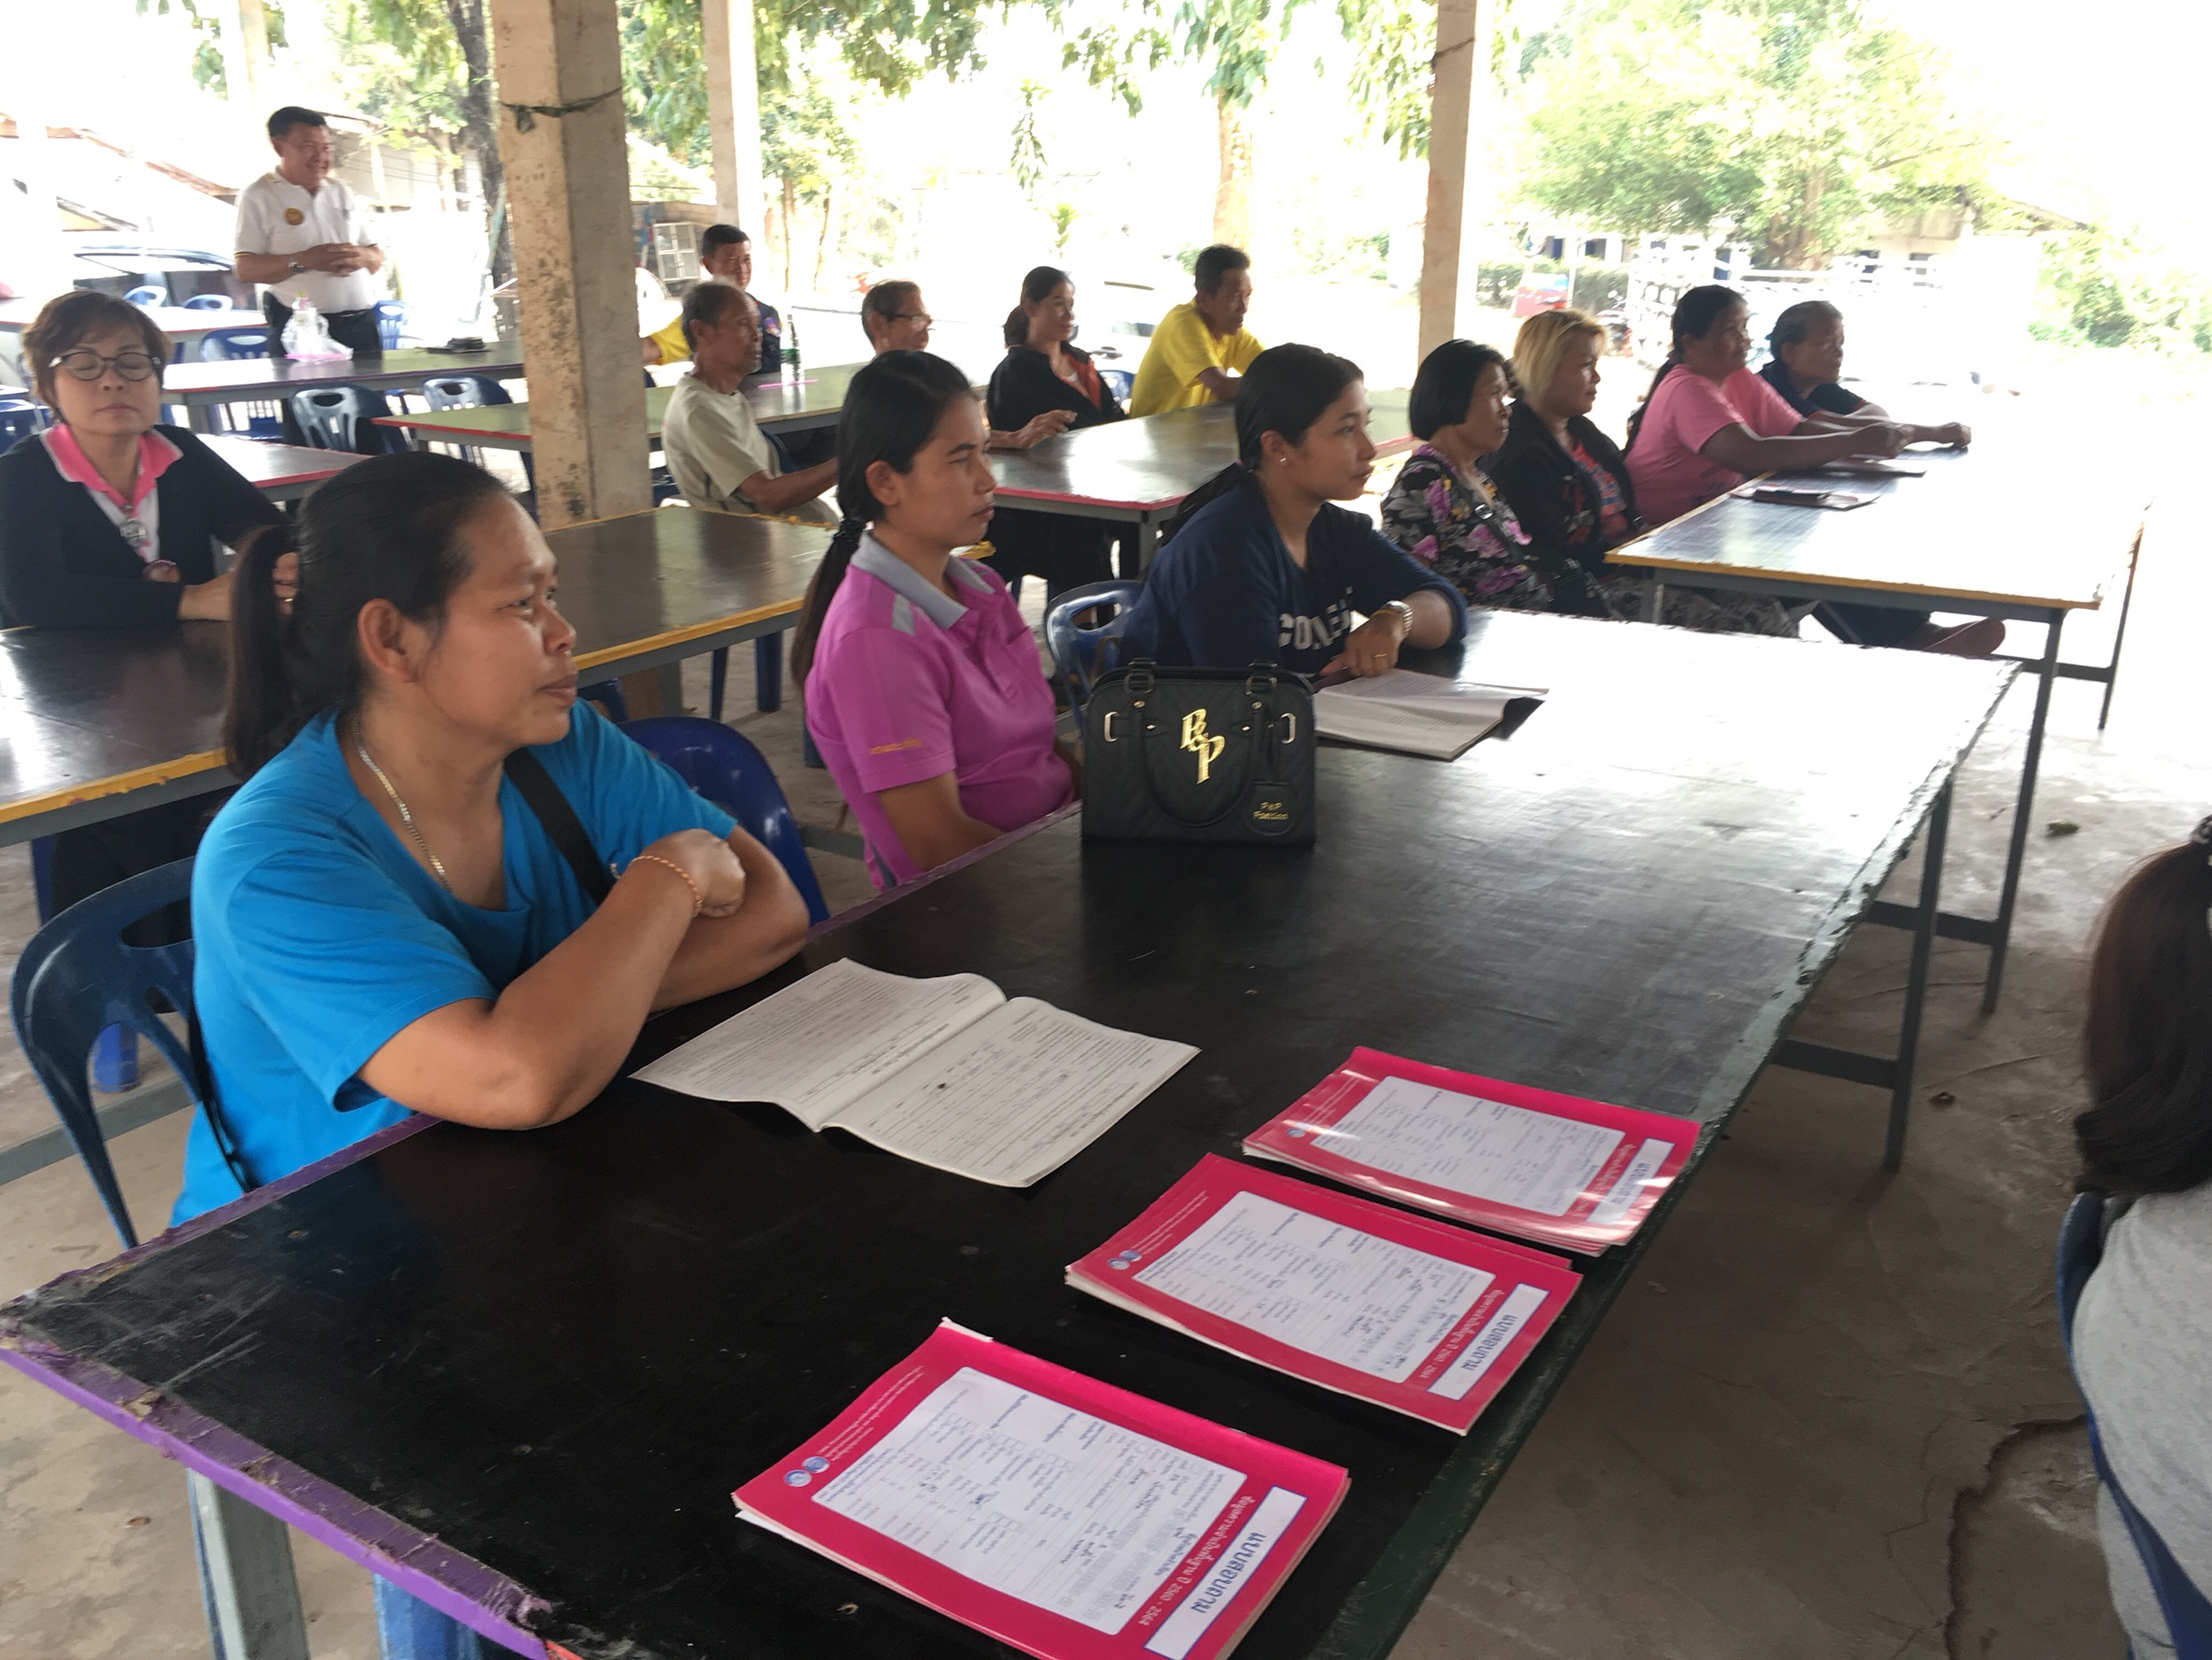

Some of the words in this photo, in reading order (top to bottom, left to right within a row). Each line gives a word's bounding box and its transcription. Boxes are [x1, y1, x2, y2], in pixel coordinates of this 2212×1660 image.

[1461, 1315, 1518, 1371] แบบสอบถาม
[1176, 1572, 1193, 1584] ปี
[1190, 1532, 1267, 1613] แบบสอบถาม
[1159, 1582, 1184, 1602] 2560
[1138, 1606, 1162, 1626] 2564
